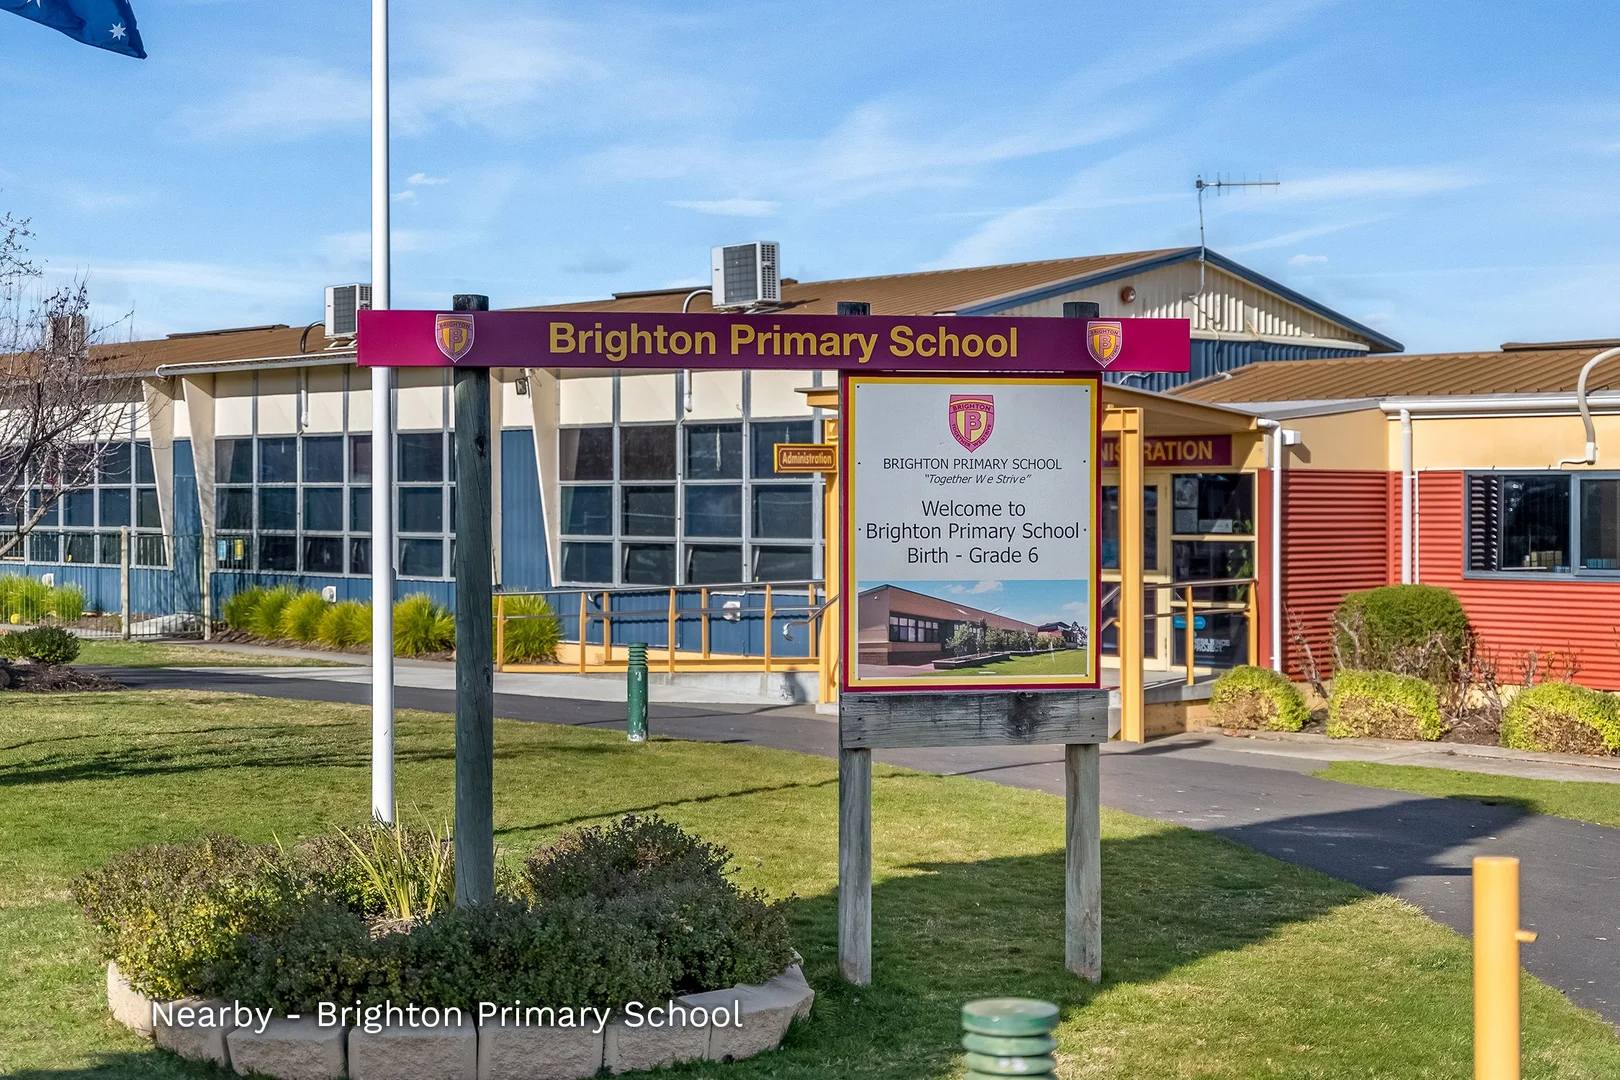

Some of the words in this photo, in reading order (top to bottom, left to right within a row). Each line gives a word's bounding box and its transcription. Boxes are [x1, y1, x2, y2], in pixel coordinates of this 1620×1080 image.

[549, 322, 716, 362] Brighton
[730, 323, 879, 364] Primary
[889, 325, 1018, 358] School
[952, 403, 991, 411] BRIGHTON
[782, 452, 832, 464] Administration
[883, 458, 949, 470] BRIGHTON
[953, 458, 1009, 470] PRIMARY
[1012, 458, 1062, 470] SCHOOL
[975, 474, 994, 484] We
[921, 500, 1002, 517] Welcome
[1008, 502, 1026, 517] to
[866, 522, 941, 543] Brighton
[949, 523, 1016, 543] Primary
[1022, 522, 1079, 540] School
[907, 547, 949, 564] Birth
[969, 547, 1022, 564] Grade
[1028, 547, 1039, 564] 6
